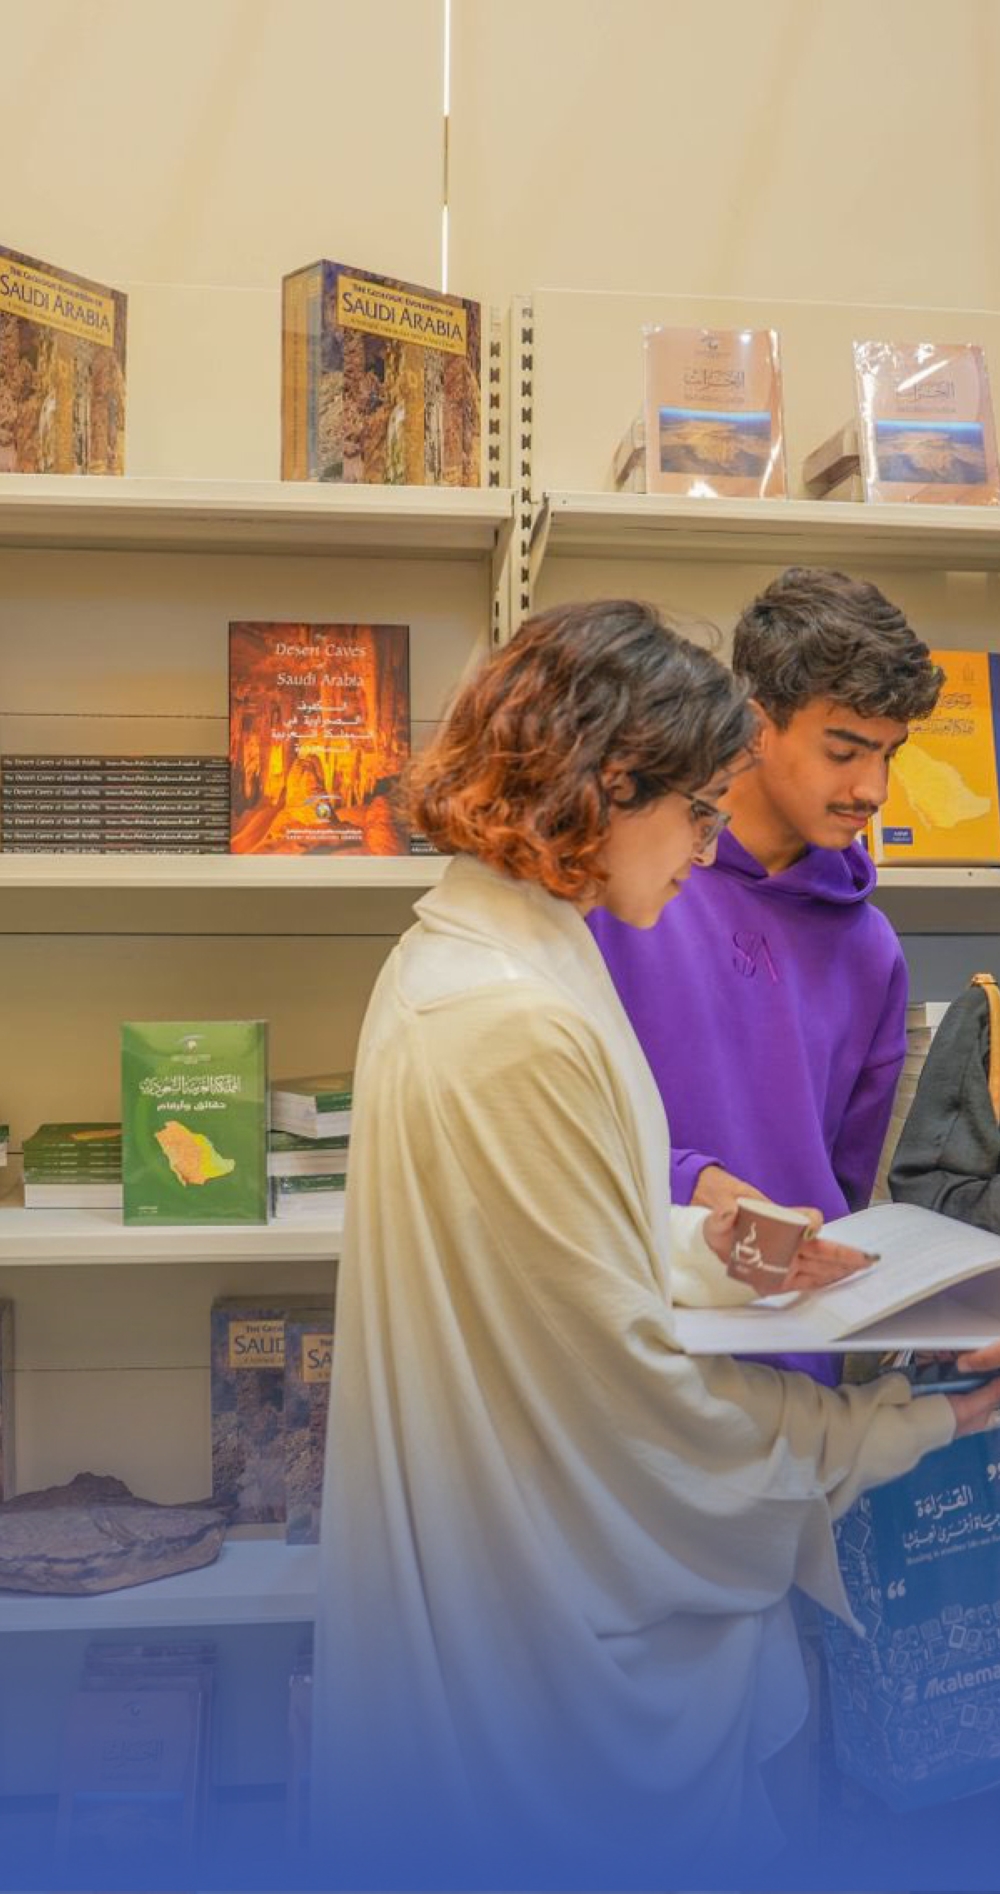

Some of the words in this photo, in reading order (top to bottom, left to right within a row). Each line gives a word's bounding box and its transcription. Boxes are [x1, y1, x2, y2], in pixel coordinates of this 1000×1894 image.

[0, 273, 50, 310] SAUDI
[53, 294, 111, 333] ARABIA
[342, 291, 395, 325] SAUDI
[399, 307, 463, 342] ARABIA
[325, 643, 368, 658] Caves
[277, 671, 317, 687] Saudi
[322, 671, 365, 688] Arabia
